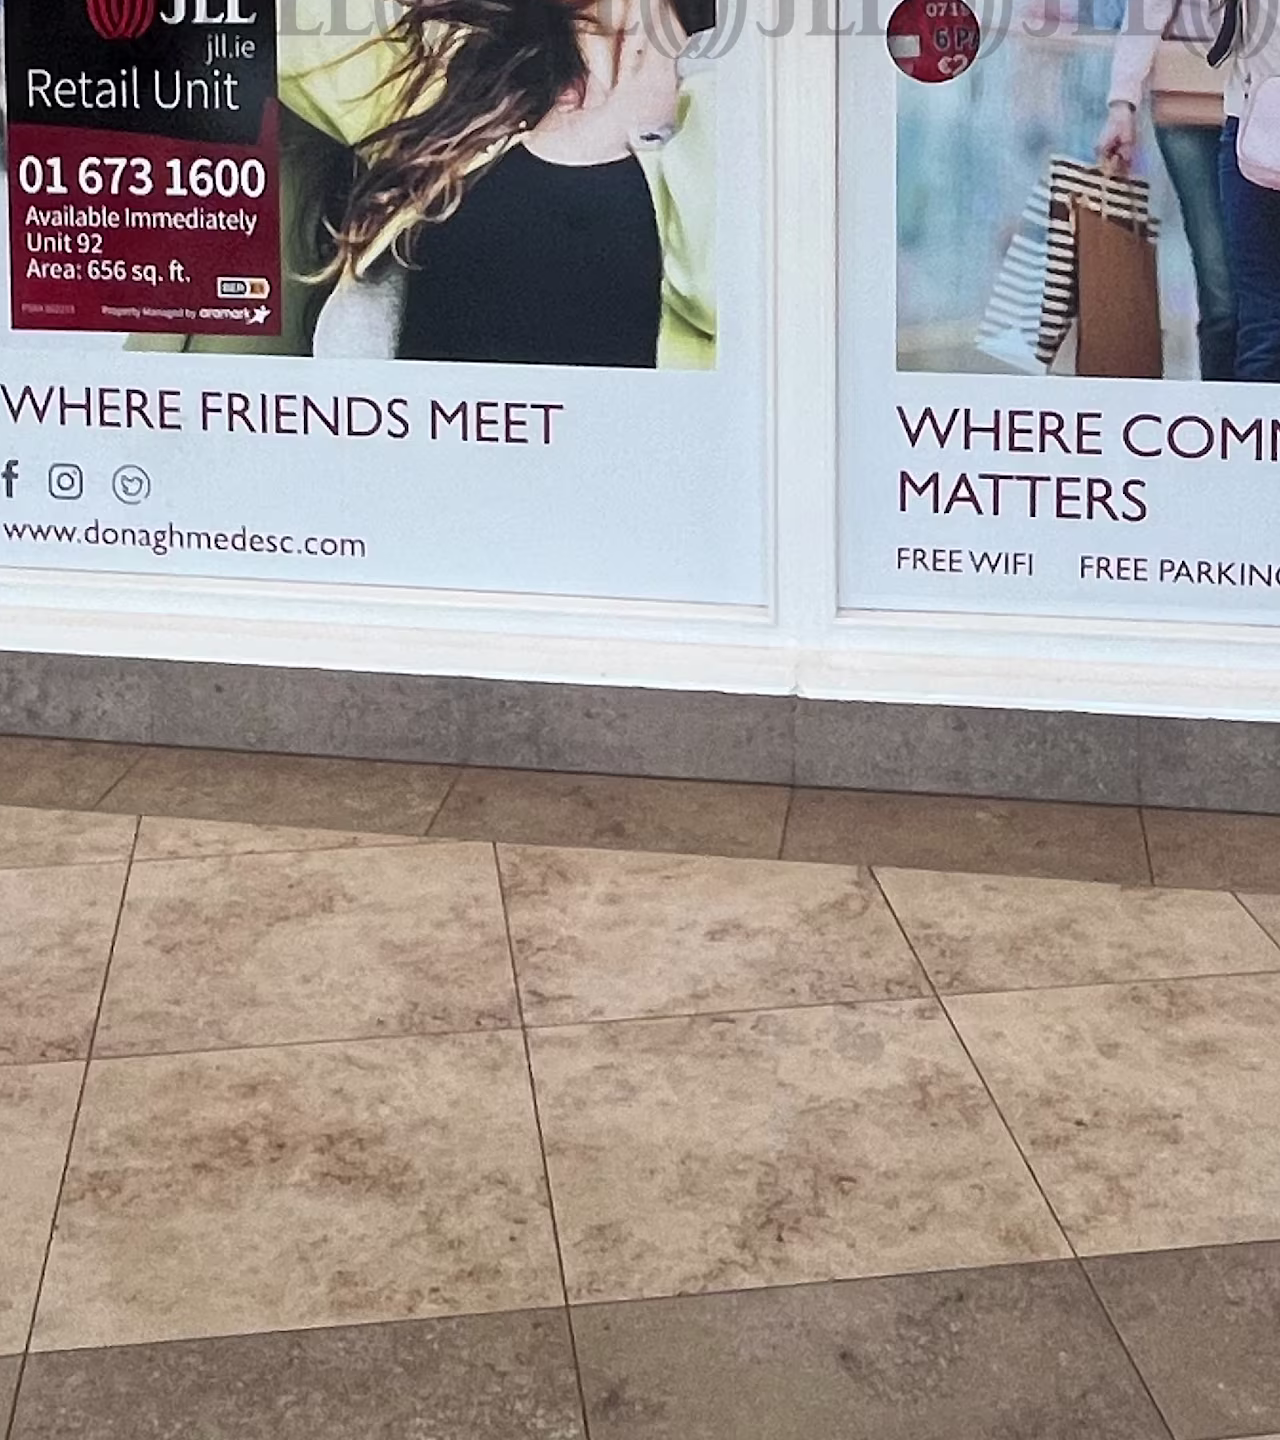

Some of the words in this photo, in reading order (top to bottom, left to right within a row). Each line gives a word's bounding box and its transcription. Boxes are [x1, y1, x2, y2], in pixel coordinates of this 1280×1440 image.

[205, 33, 256, 65] jll.ie
[27, 66, 140, 109] Retail
[155, 69, 240, 110] Unit
[19, 155, 67, 194] 01
[78, 156, 154, 196] 673
[165, 158, 266, 198] 1600
[25, 205, 120, 228] Available
[125, 207, 257, 236] Immediately
[27, 232, 72, 253] Unit
[77, 234, 103, 254] 92
[26, 258, 81, 279] Area:
[87, 260, 127, 281] 656
[131, 265, 164, 287] sq.
[169, 259, 191, 284] ft.
[0, 383, 182, 430] WHERE
[201, 391, 409, 439] FRIENDS
[431, 400, 564, 444] MEET
[896, 406, 1102, 455] WHERE
[899, 470, 1147, 522] MATTERS
[3, 519, 366, 557] www.donaghmedesc.com
[897, 547, 962, 572] FREE
[968, 551, 1033, 576] WIFI
[1080, 555, 1148, 581] FREE
